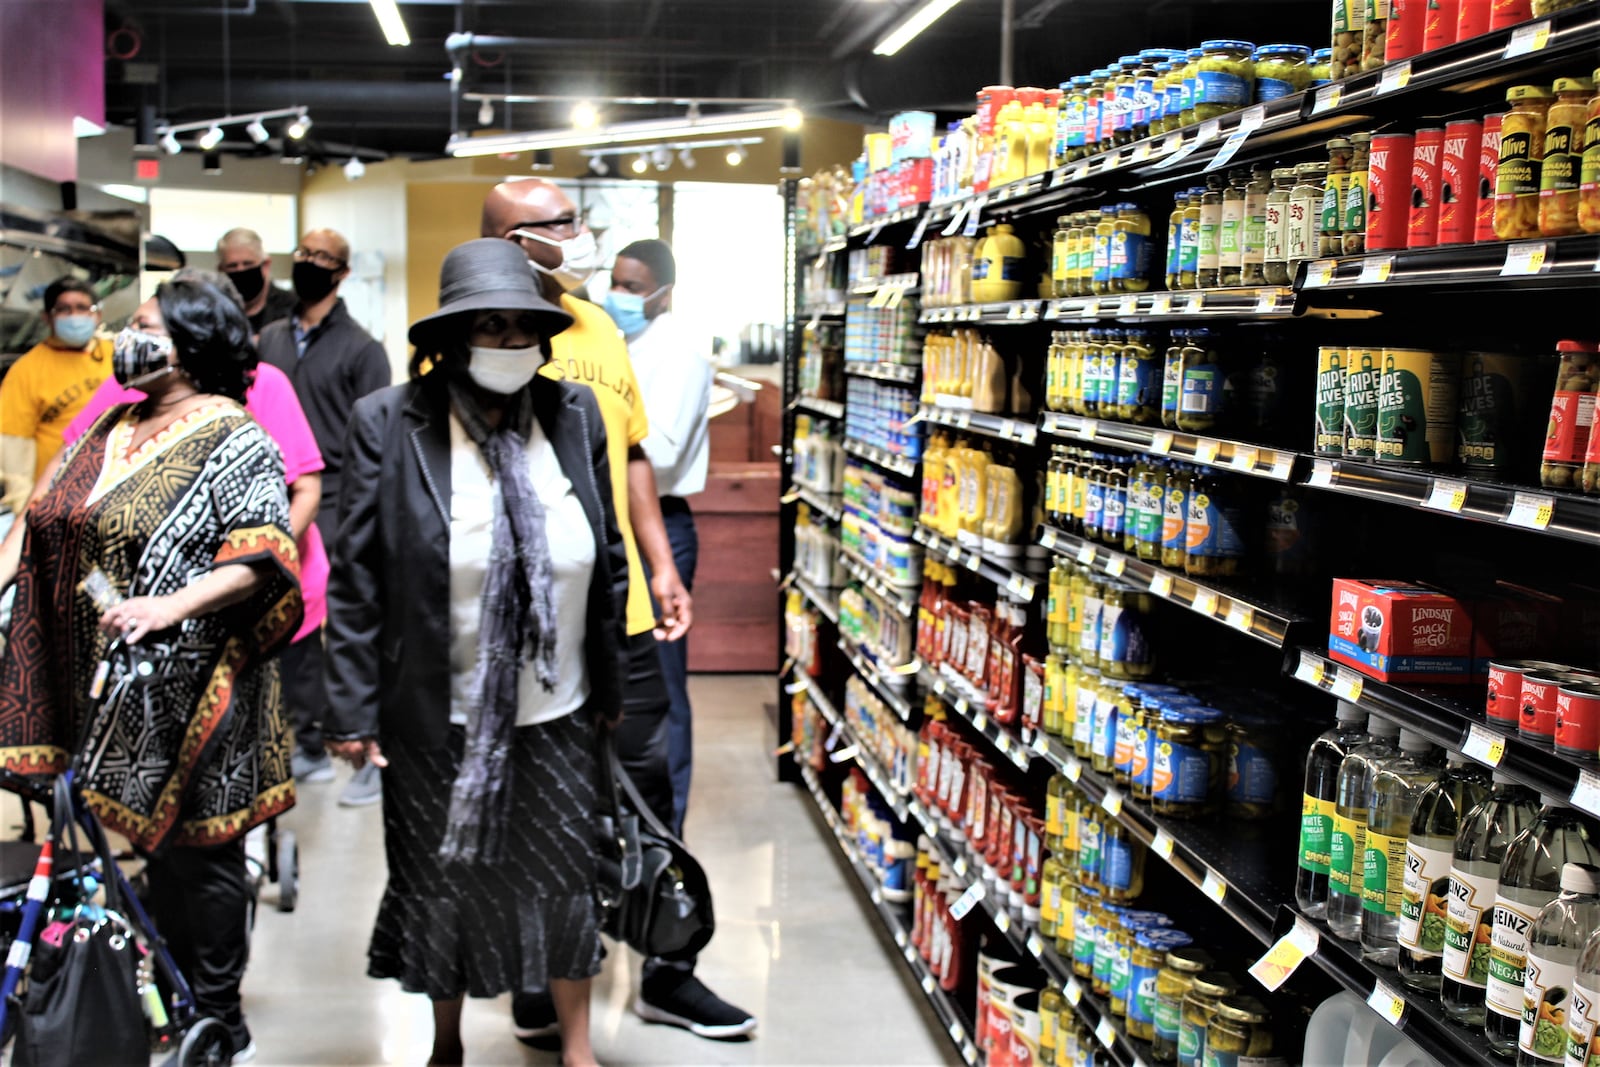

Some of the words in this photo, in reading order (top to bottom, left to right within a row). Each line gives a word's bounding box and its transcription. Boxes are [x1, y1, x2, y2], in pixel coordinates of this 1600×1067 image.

[1351, 370, 1380, 394] RIPE
[1412, 607, 1454, 623] LINDSAY
[1427, 633, 1446, 647] GO
